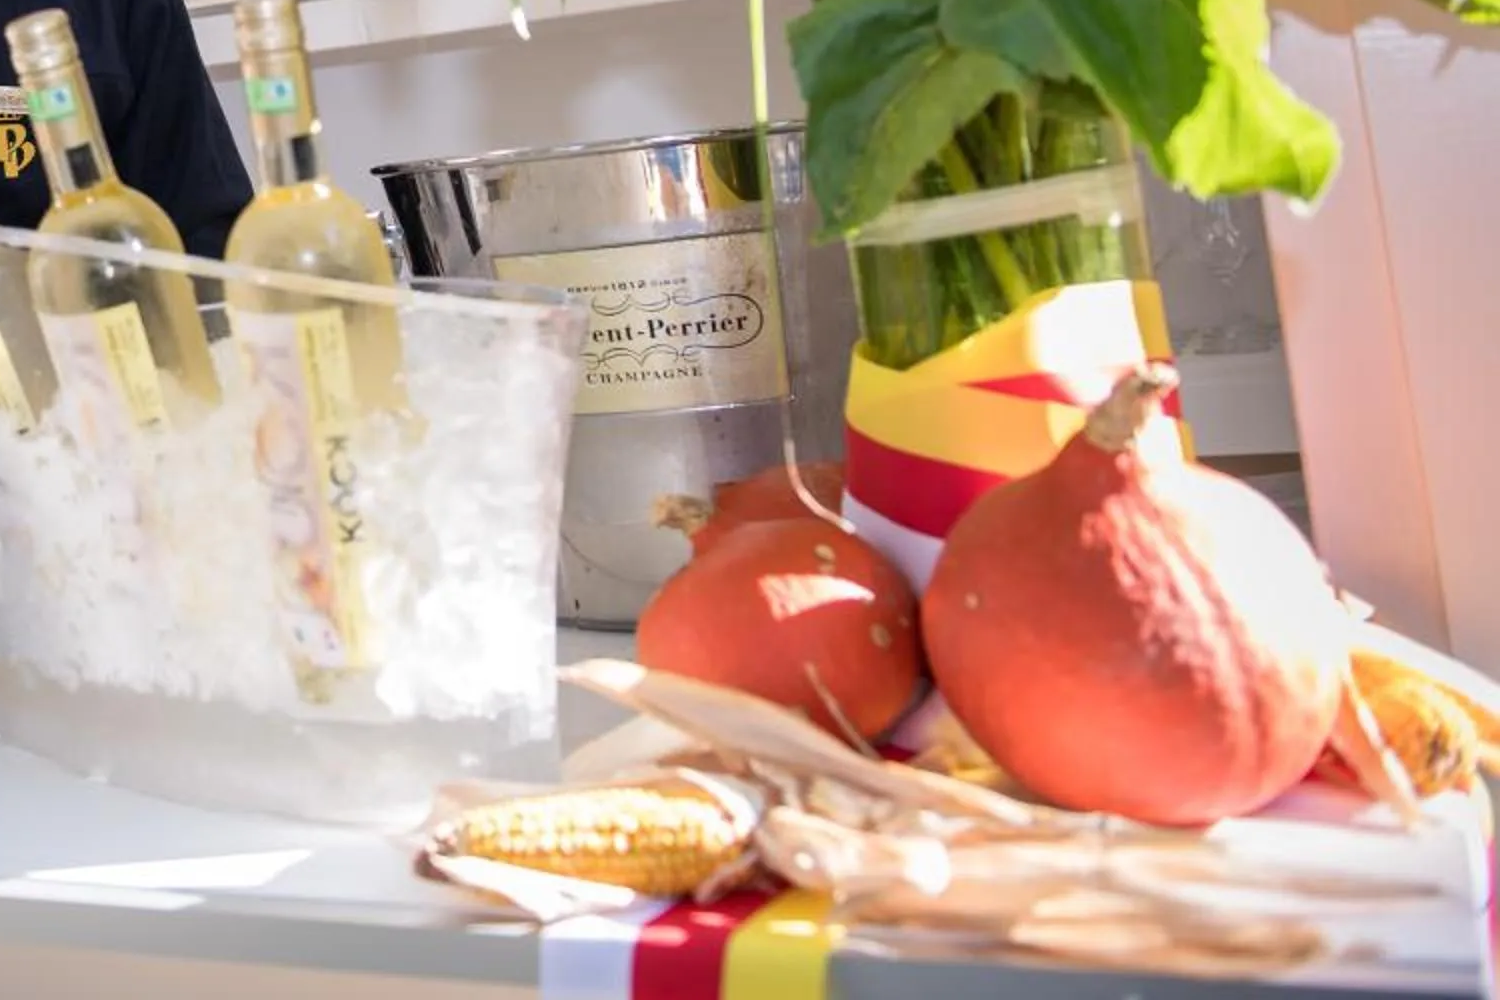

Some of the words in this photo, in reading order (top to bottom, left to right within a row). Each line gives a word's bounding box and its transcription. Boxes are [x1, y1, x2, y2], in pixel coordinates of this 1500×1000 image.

[610, 280, 645, 291] 1812
[591, 313, 748, 343] ent-Perrier
[586, 366, 703, 385] CHAMPAGNE
